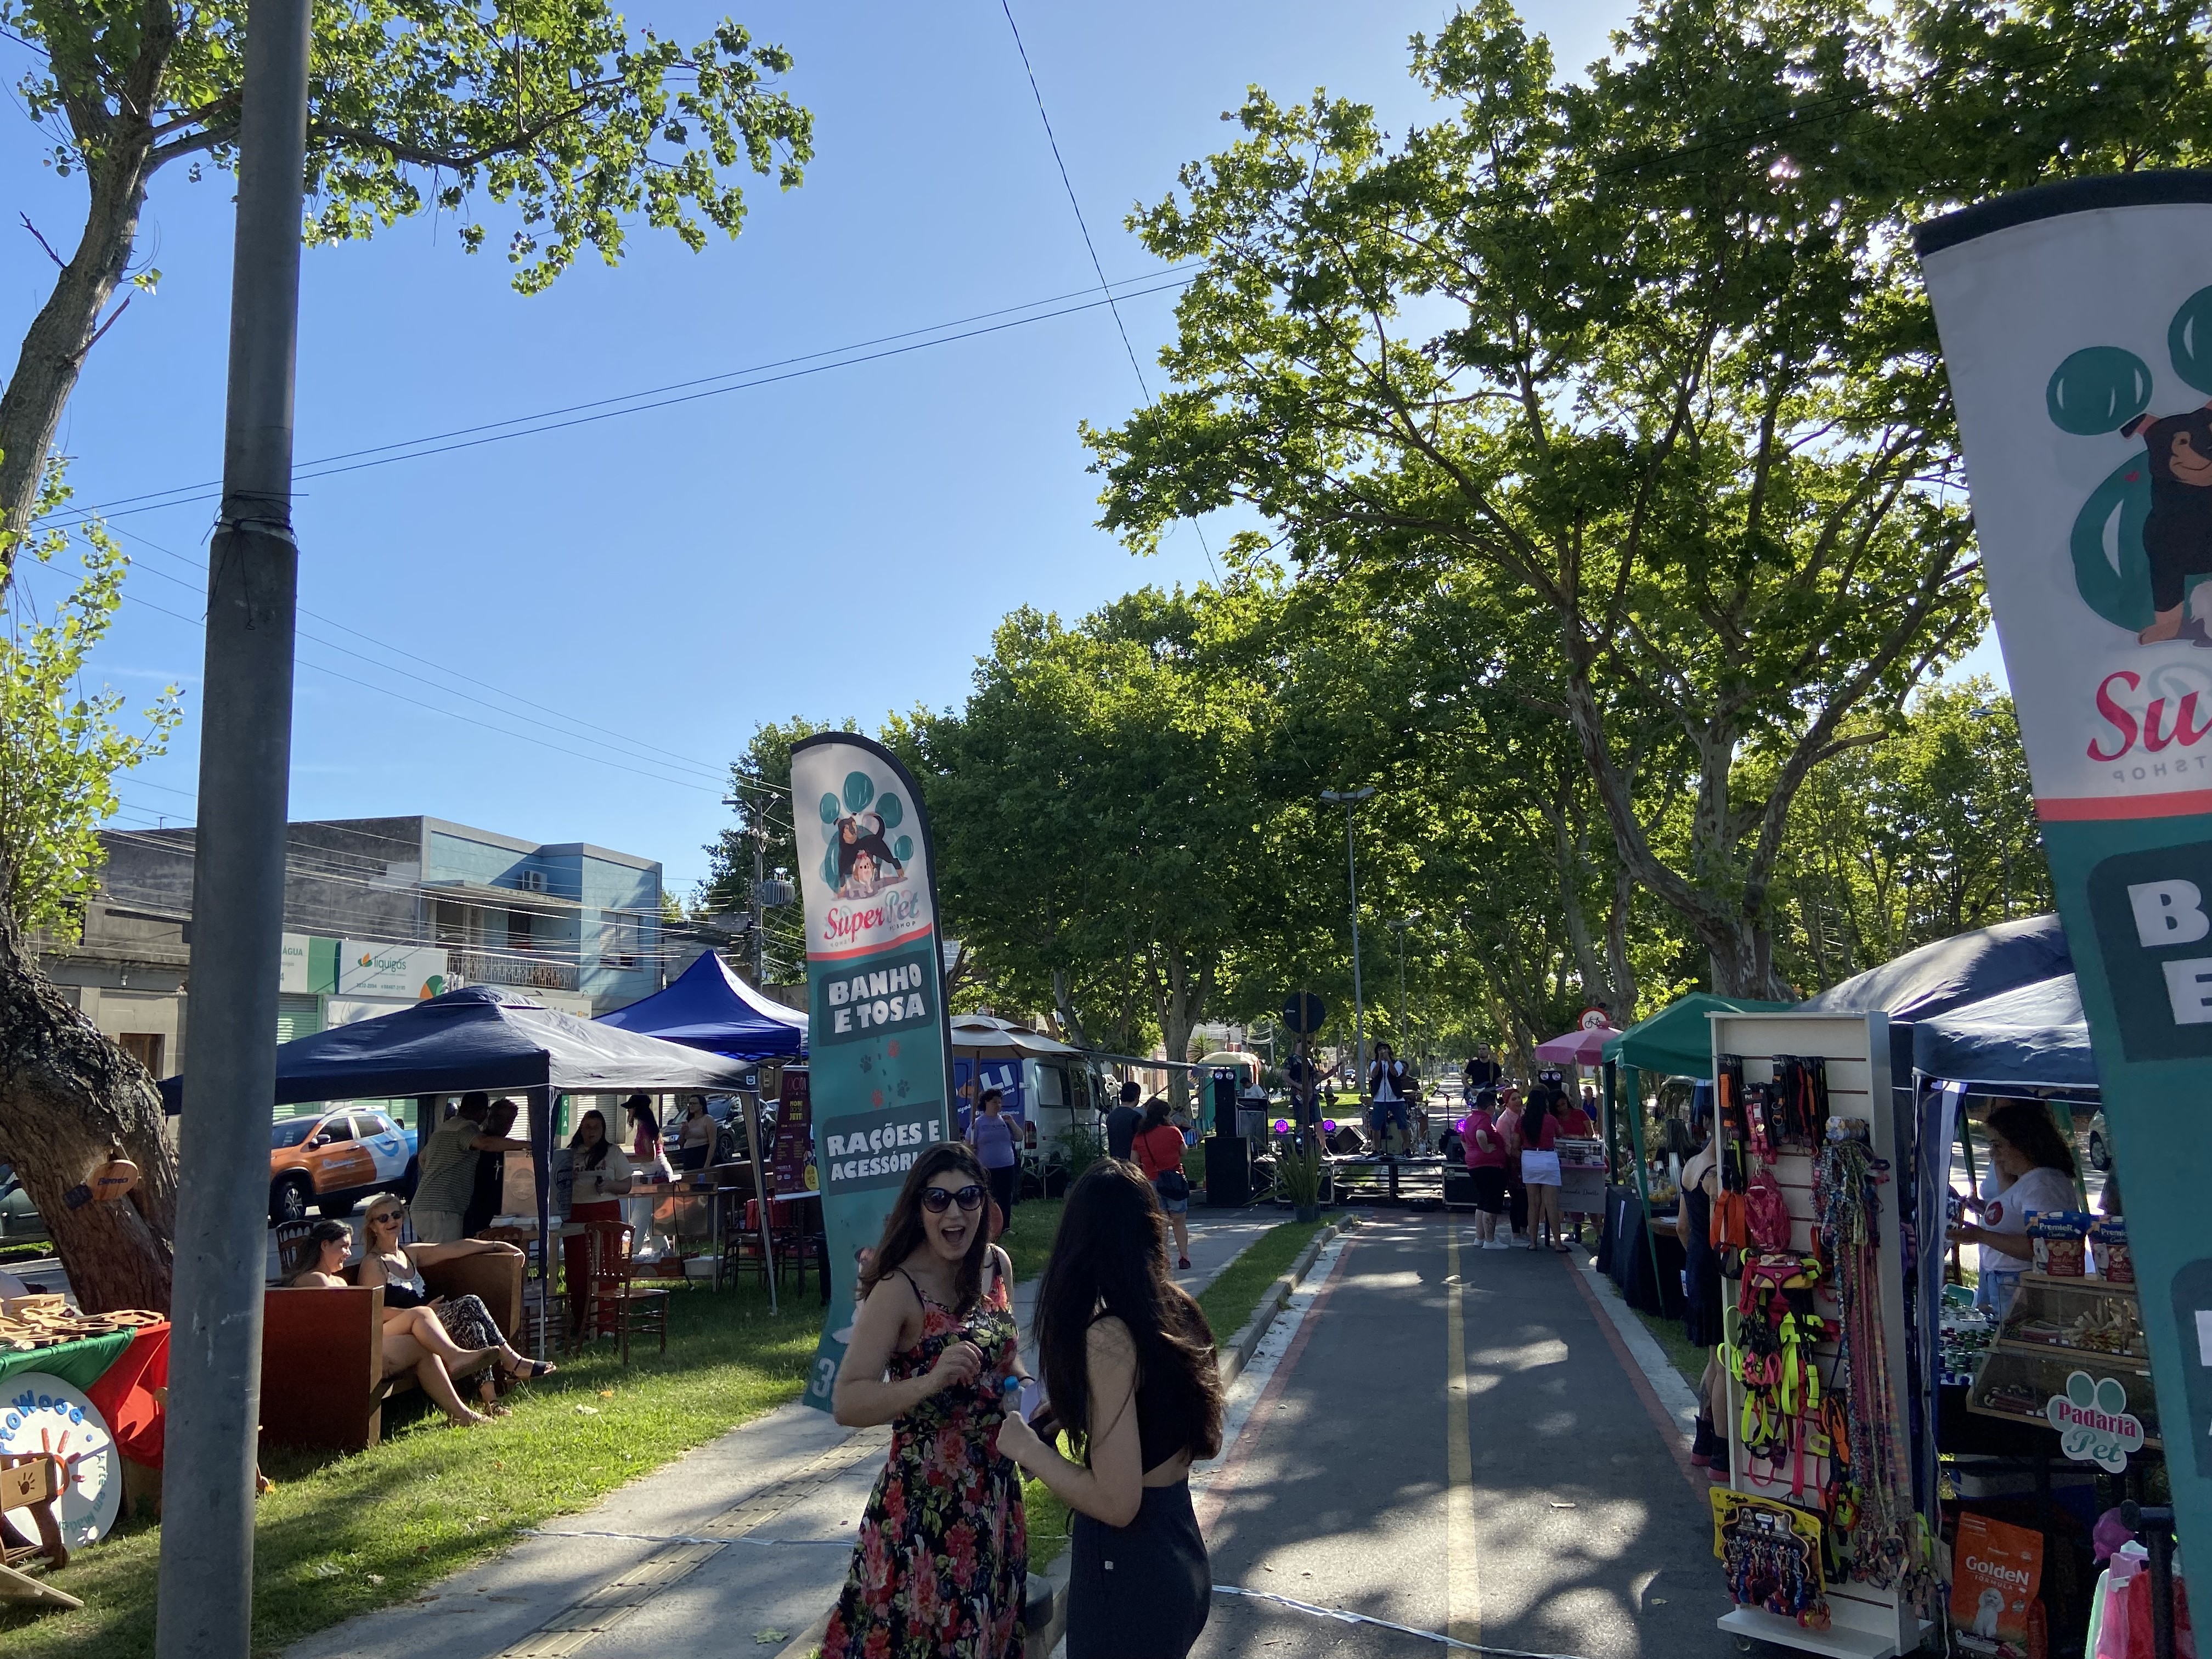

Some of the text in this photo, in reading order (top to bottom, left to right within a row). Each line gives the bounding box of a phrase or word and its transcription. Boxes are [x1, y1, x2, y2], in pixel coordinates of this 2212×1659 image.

[824, 890, 919, 943] Super Pet
[283, 945, 303, 956] ÁGUA
[374, 956, 407, 972] liquigás
[829, 963, 922, 1006] BANHO
[2162, 957, 2212, 1025] E
[834, 992, 926, 1034] E TOSA
[827, 1122, 922, 1157] RAÇÕES
[928, 1119, 940, 1142] E
[831, 1150, 924, 1182] ACESSÓRI
[2058, 1402, 2136, 1438] Padaria
[2067, 1430, 2121, 1463] Pet
[1975, 1574, 2014, 1591] FORMULA
